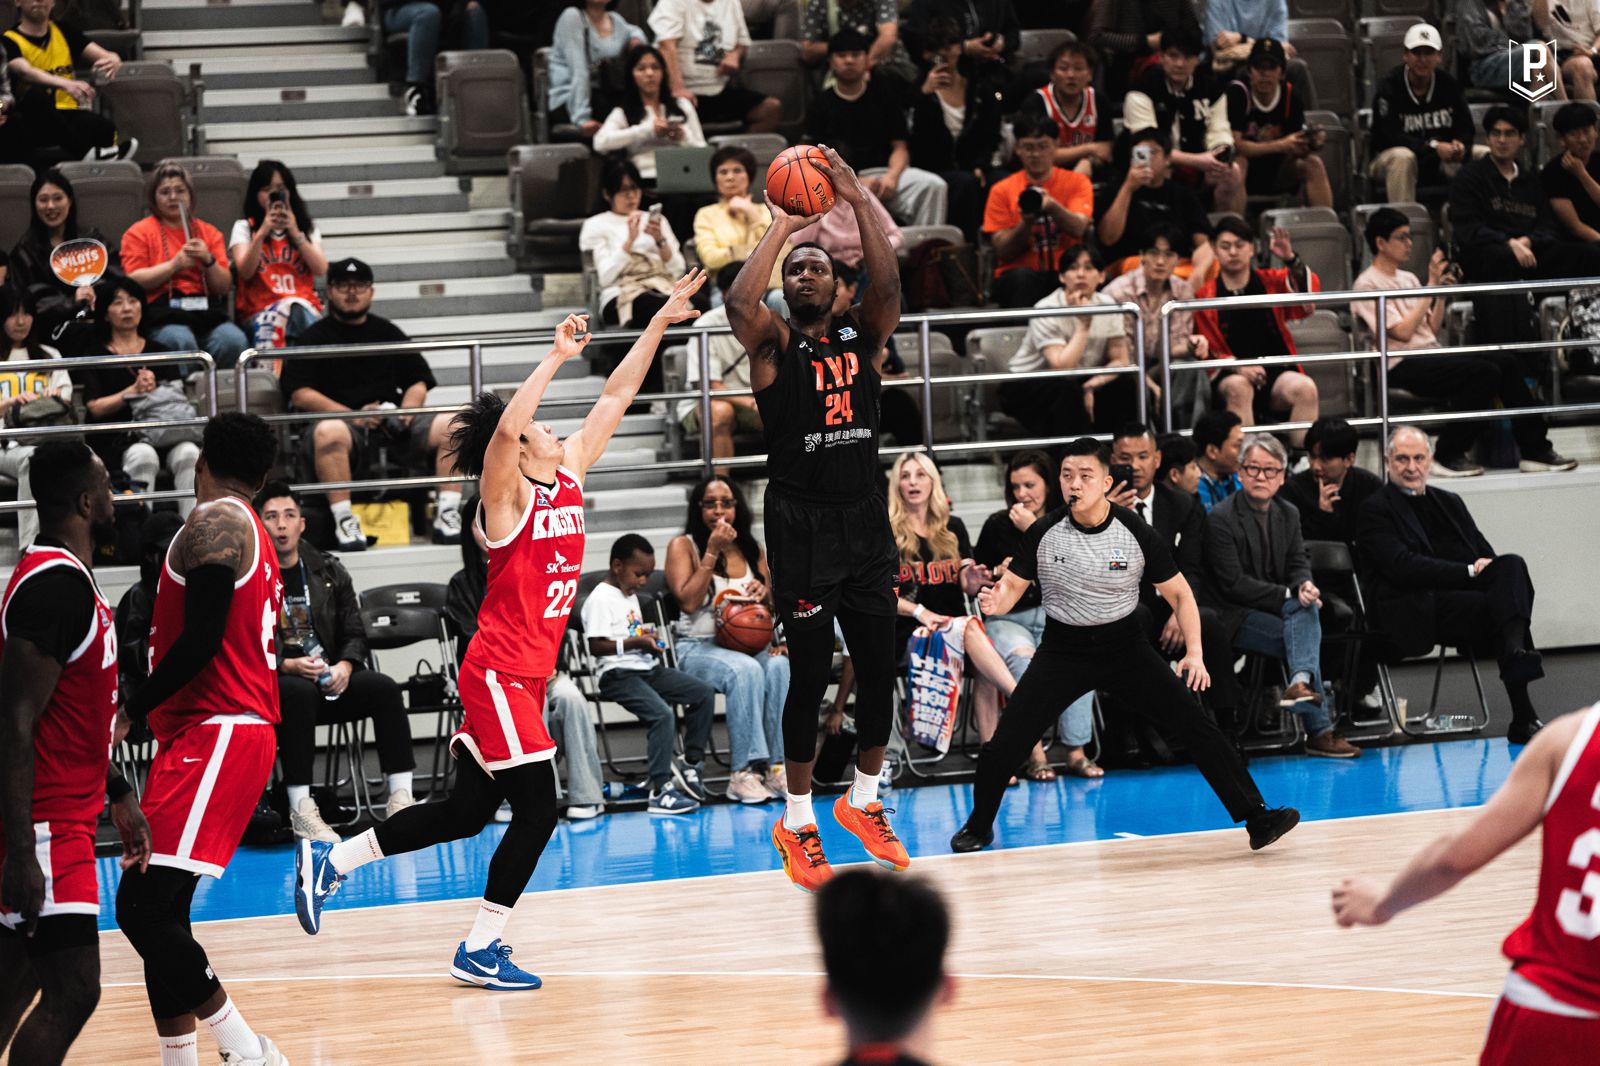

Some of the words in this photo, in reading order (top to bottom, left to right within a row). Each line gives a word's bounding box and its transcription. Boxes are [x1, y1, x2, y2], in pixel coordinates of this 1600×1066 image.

[270, 273, 296, 294] 30
[825, 390, 853, 425] 24
[546, 562, 559, 574] SK
[543, 579, 577, 618] 22
